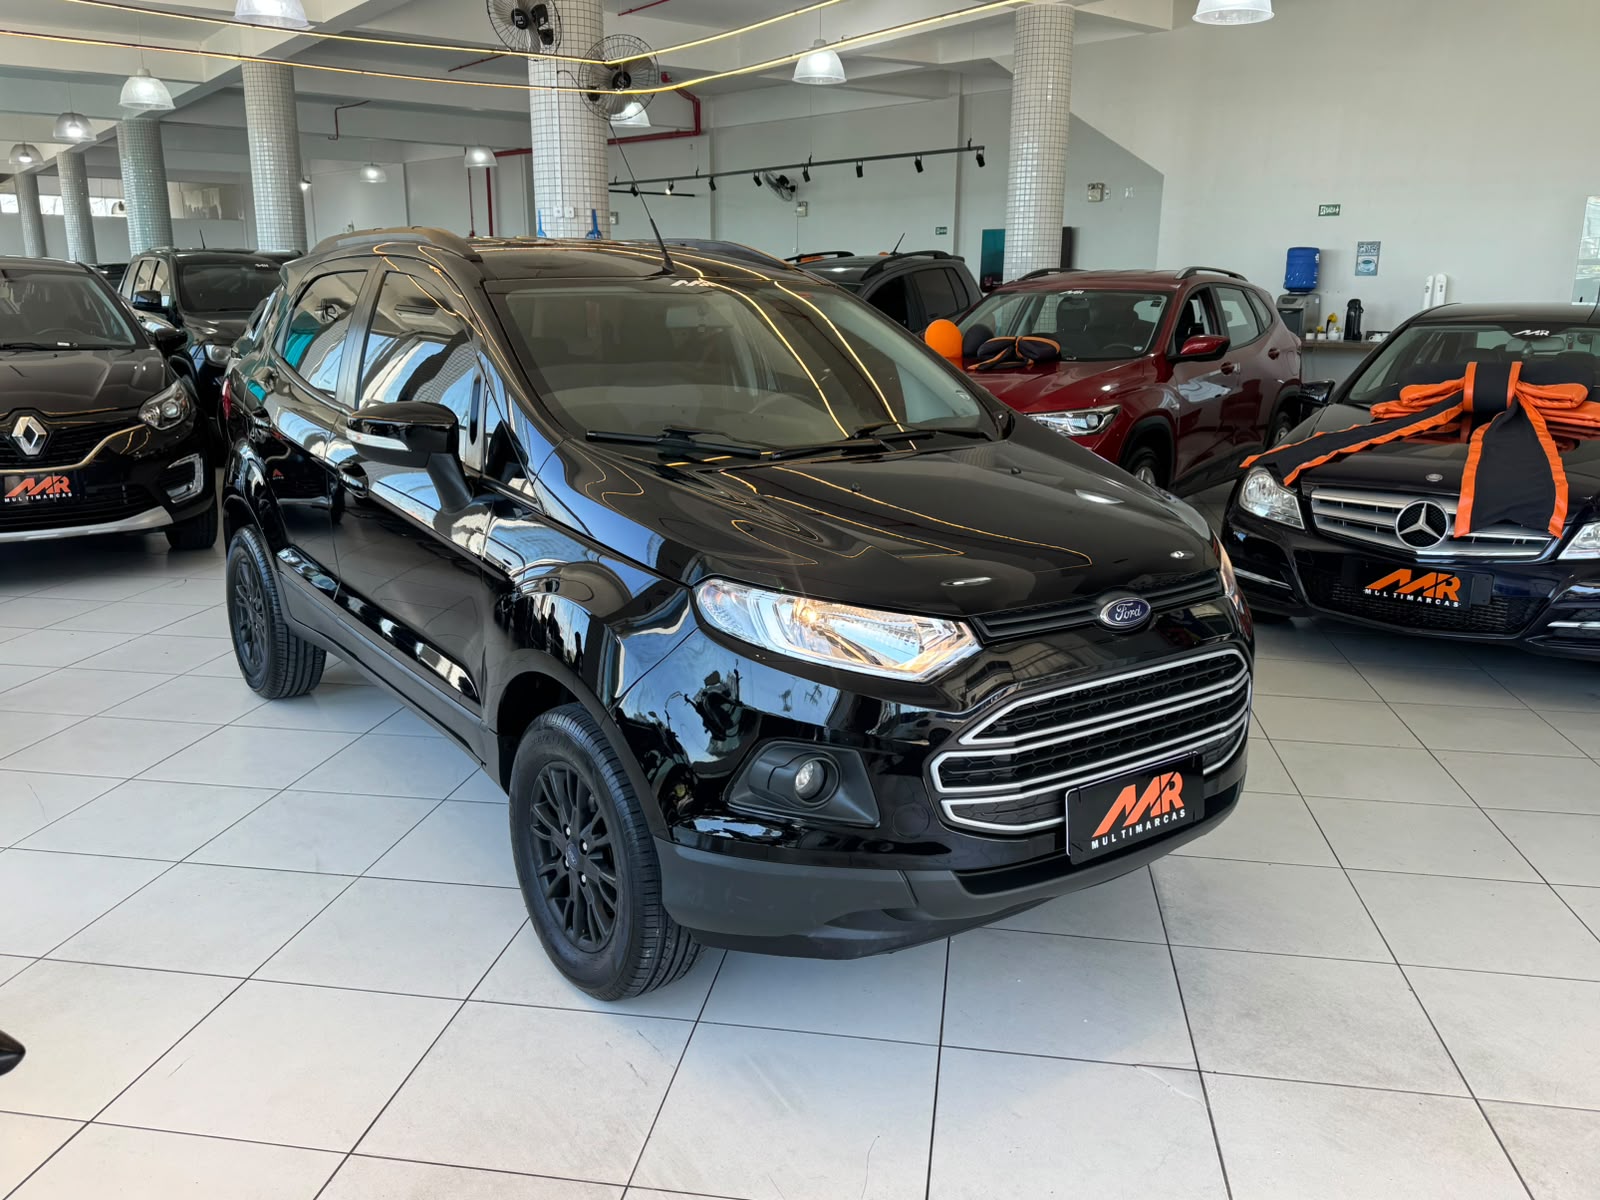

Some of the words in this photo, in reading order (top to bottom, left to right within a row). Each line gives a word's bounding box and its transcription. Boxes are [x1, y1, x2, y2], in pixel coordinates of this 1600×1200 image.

[4, 492, 73, 503] MULTIMARCAS
[1363, 588, 1459, 608] MULTIMARCAS
[1114, 602, 1142, 621] Ford
[1091, 808, 1186, 850] MULTIMARCAS
